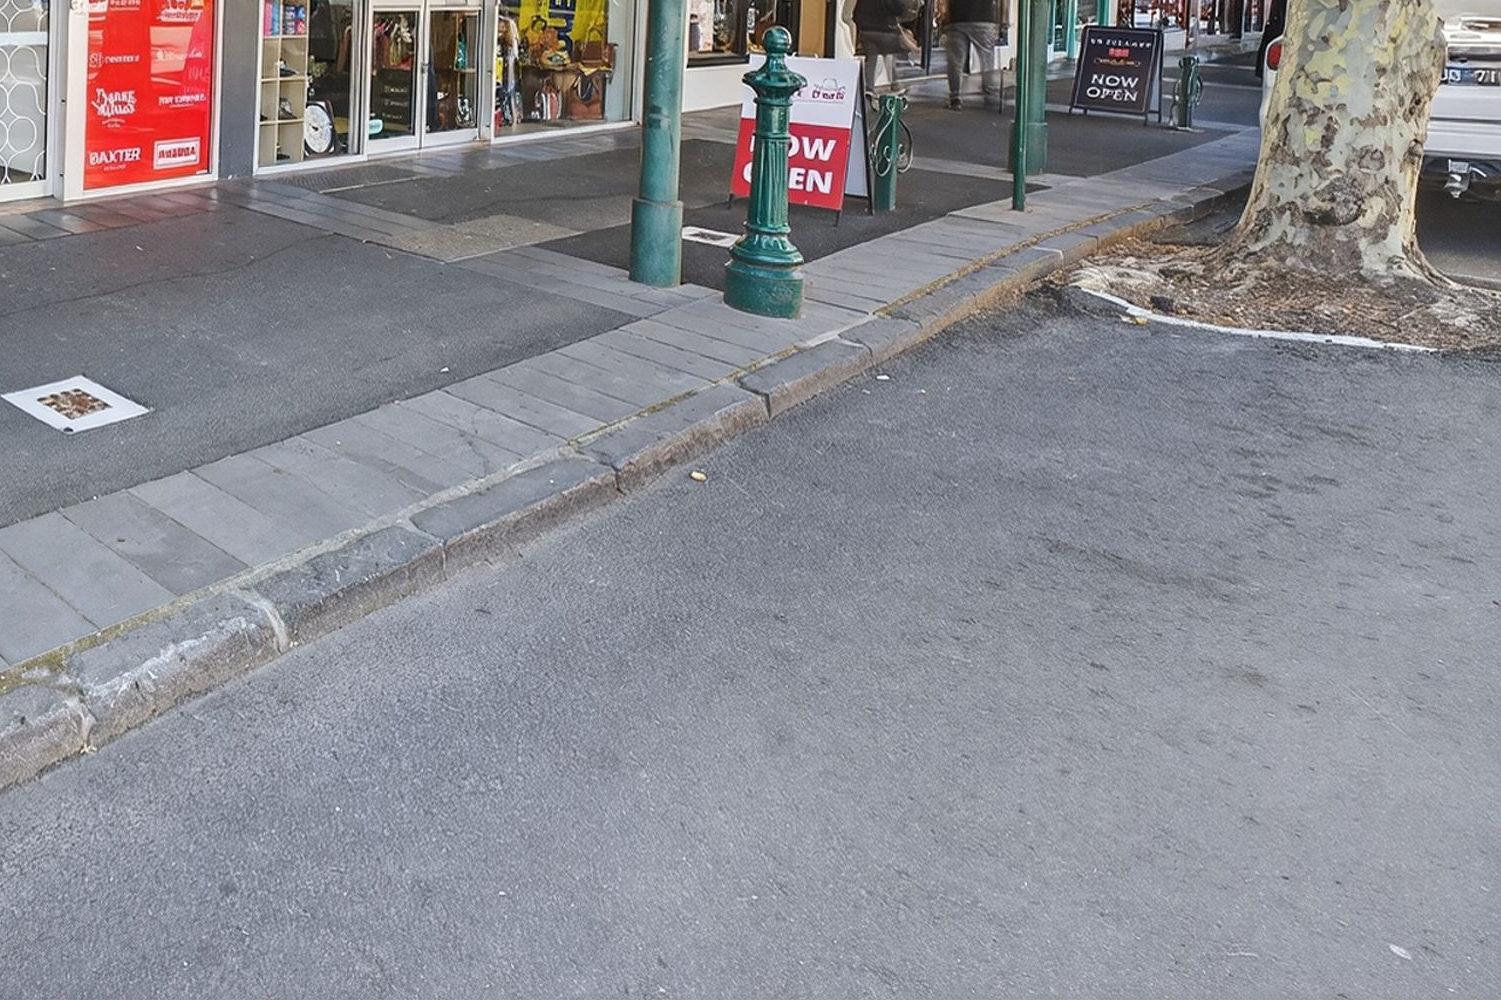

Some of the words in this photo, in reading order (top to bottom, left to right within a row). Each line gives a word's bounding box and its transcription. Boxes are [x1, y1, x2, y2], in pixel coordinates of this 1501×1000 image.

[1091, 74, 1139, 88] NOW
[1086, 86, 1138, 102] OPEN
[90, 148, 141, 165] BAXTER
